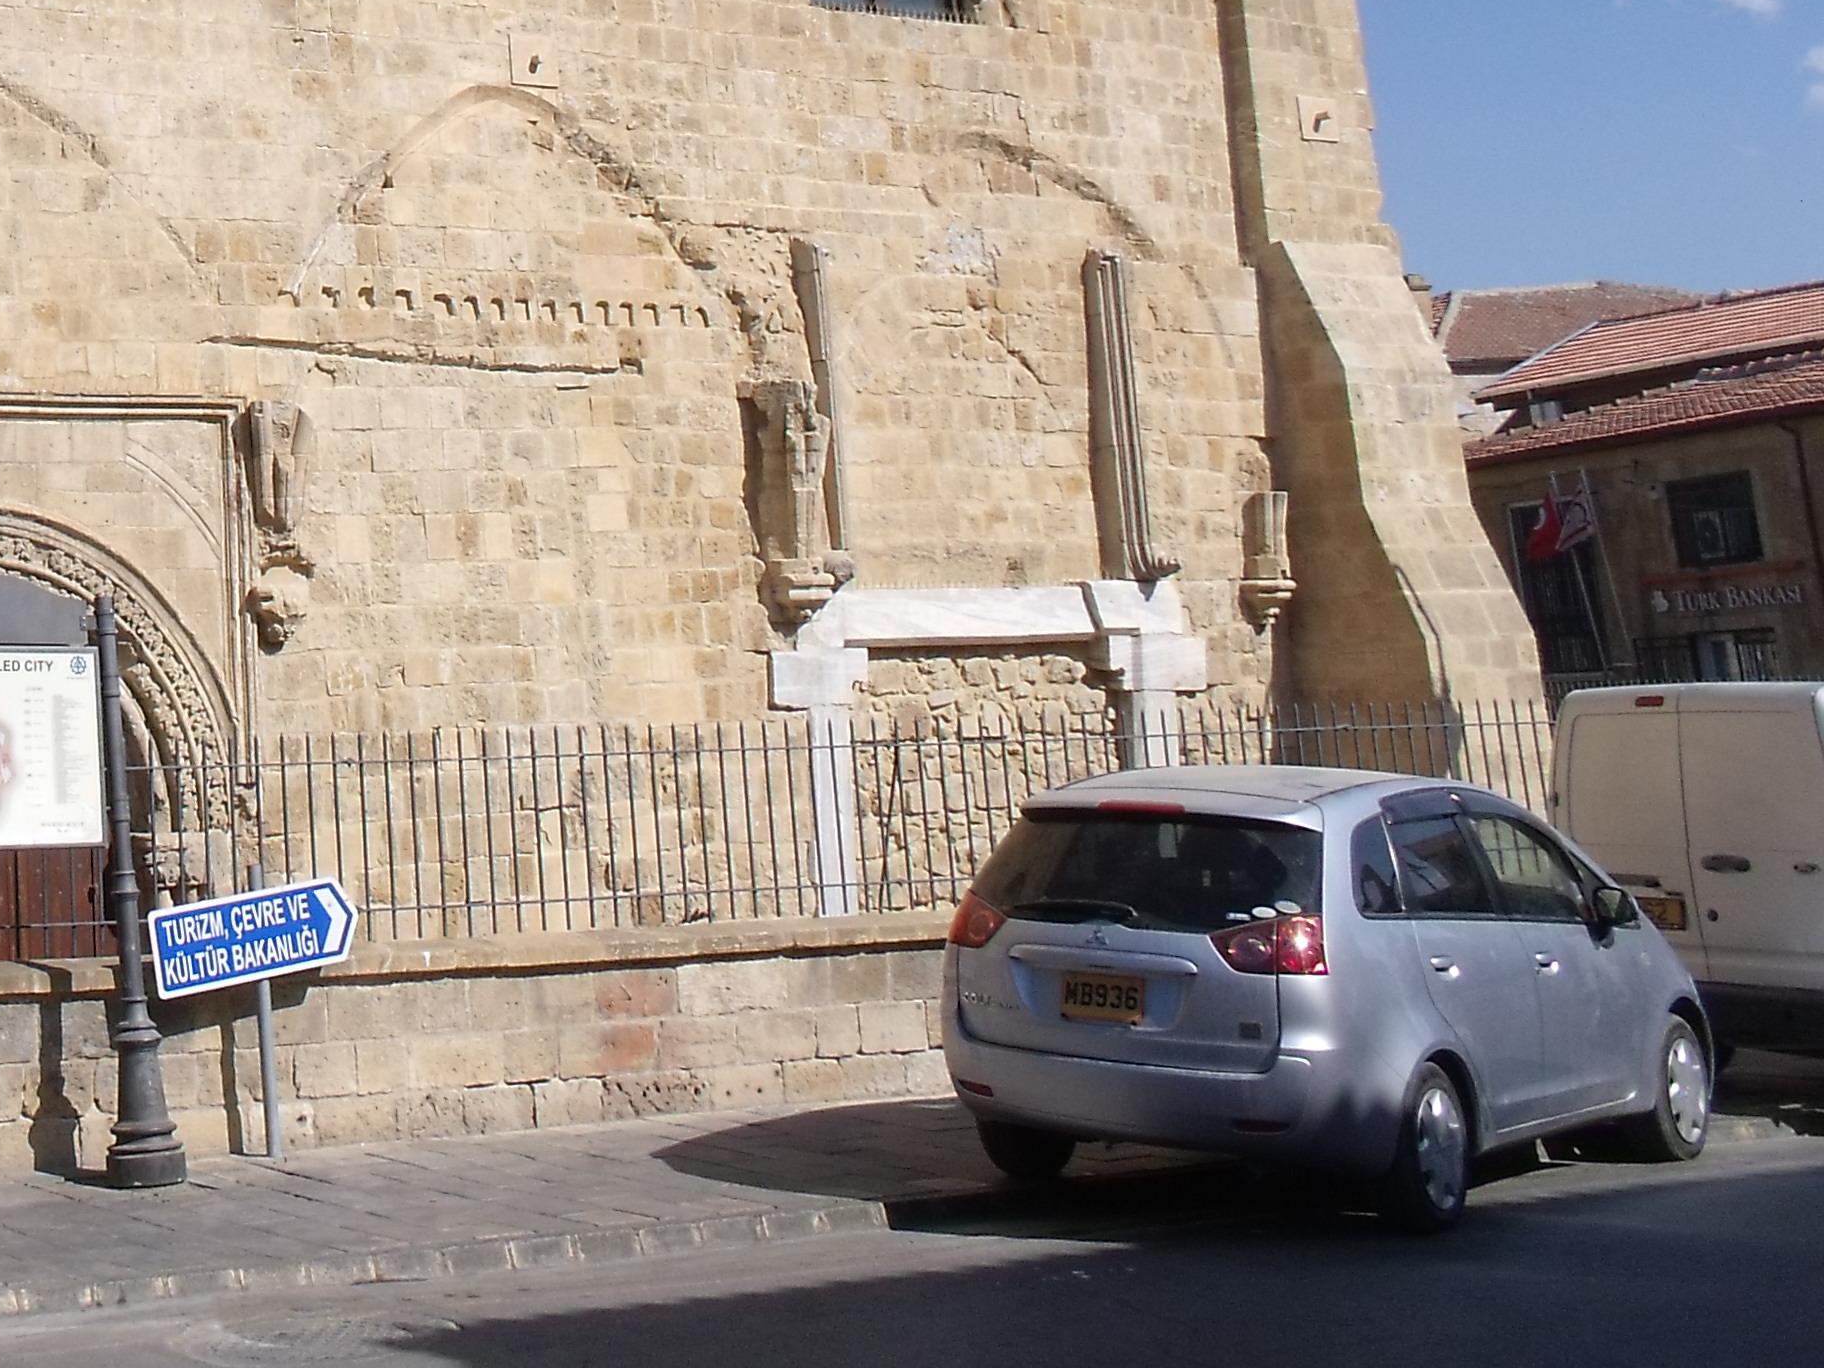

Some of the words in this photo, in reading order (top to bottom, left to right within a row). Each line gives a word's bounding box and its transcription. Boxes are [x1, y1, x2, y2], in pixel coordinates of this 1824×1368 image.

[24, 660, 54, 672] CITY
[230, 898, 286, 939] ÇEVRE
[286, 893, 311, 921] VE
[163, 944, 231, 986] KÜLTÜR
[231, 924, 320, 972] BAKANLIĞI
[1065, 980, 1139, 1010] MB936
